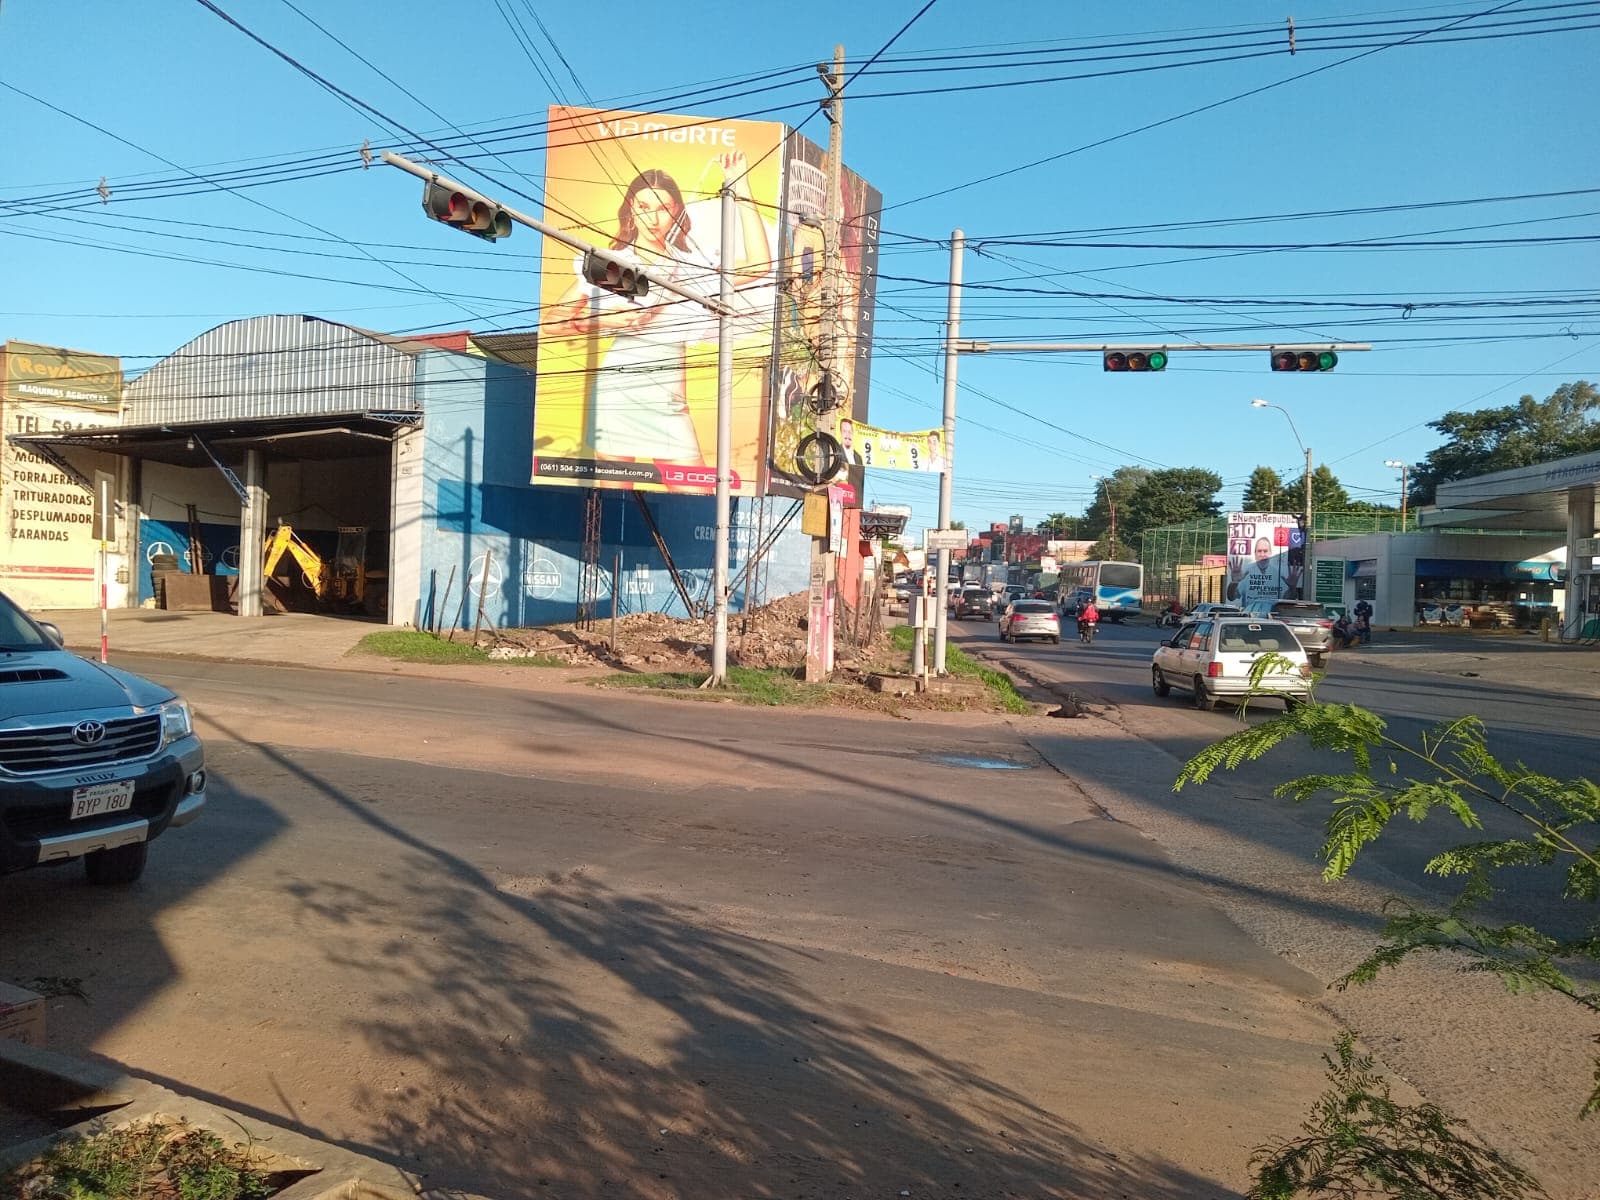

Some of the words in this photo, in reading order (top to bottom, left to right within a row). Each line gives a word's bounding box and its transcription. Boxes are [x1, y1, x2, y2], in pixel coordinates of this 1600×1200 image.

[864, 442, 872, 454] 9
[910, 448, 918, 459] 9
[866, 456, 872, 465] 2
[913, 460, 919, 470] 3
[540, 463, 559, 472] (061)
[560, 464, 574, 473] 504
[13, 489, 92, 506] TRITURADORAS
[11, 528, 70, 541] ZARANDAS
[526, 575, 560, 586] NISSAN
[626, 581, 654, 595] ISUZU
[75, 772, 118, 784] HILUX
[76, 798, 101, 816] BYP
[105, 794, 128, 811] 180
